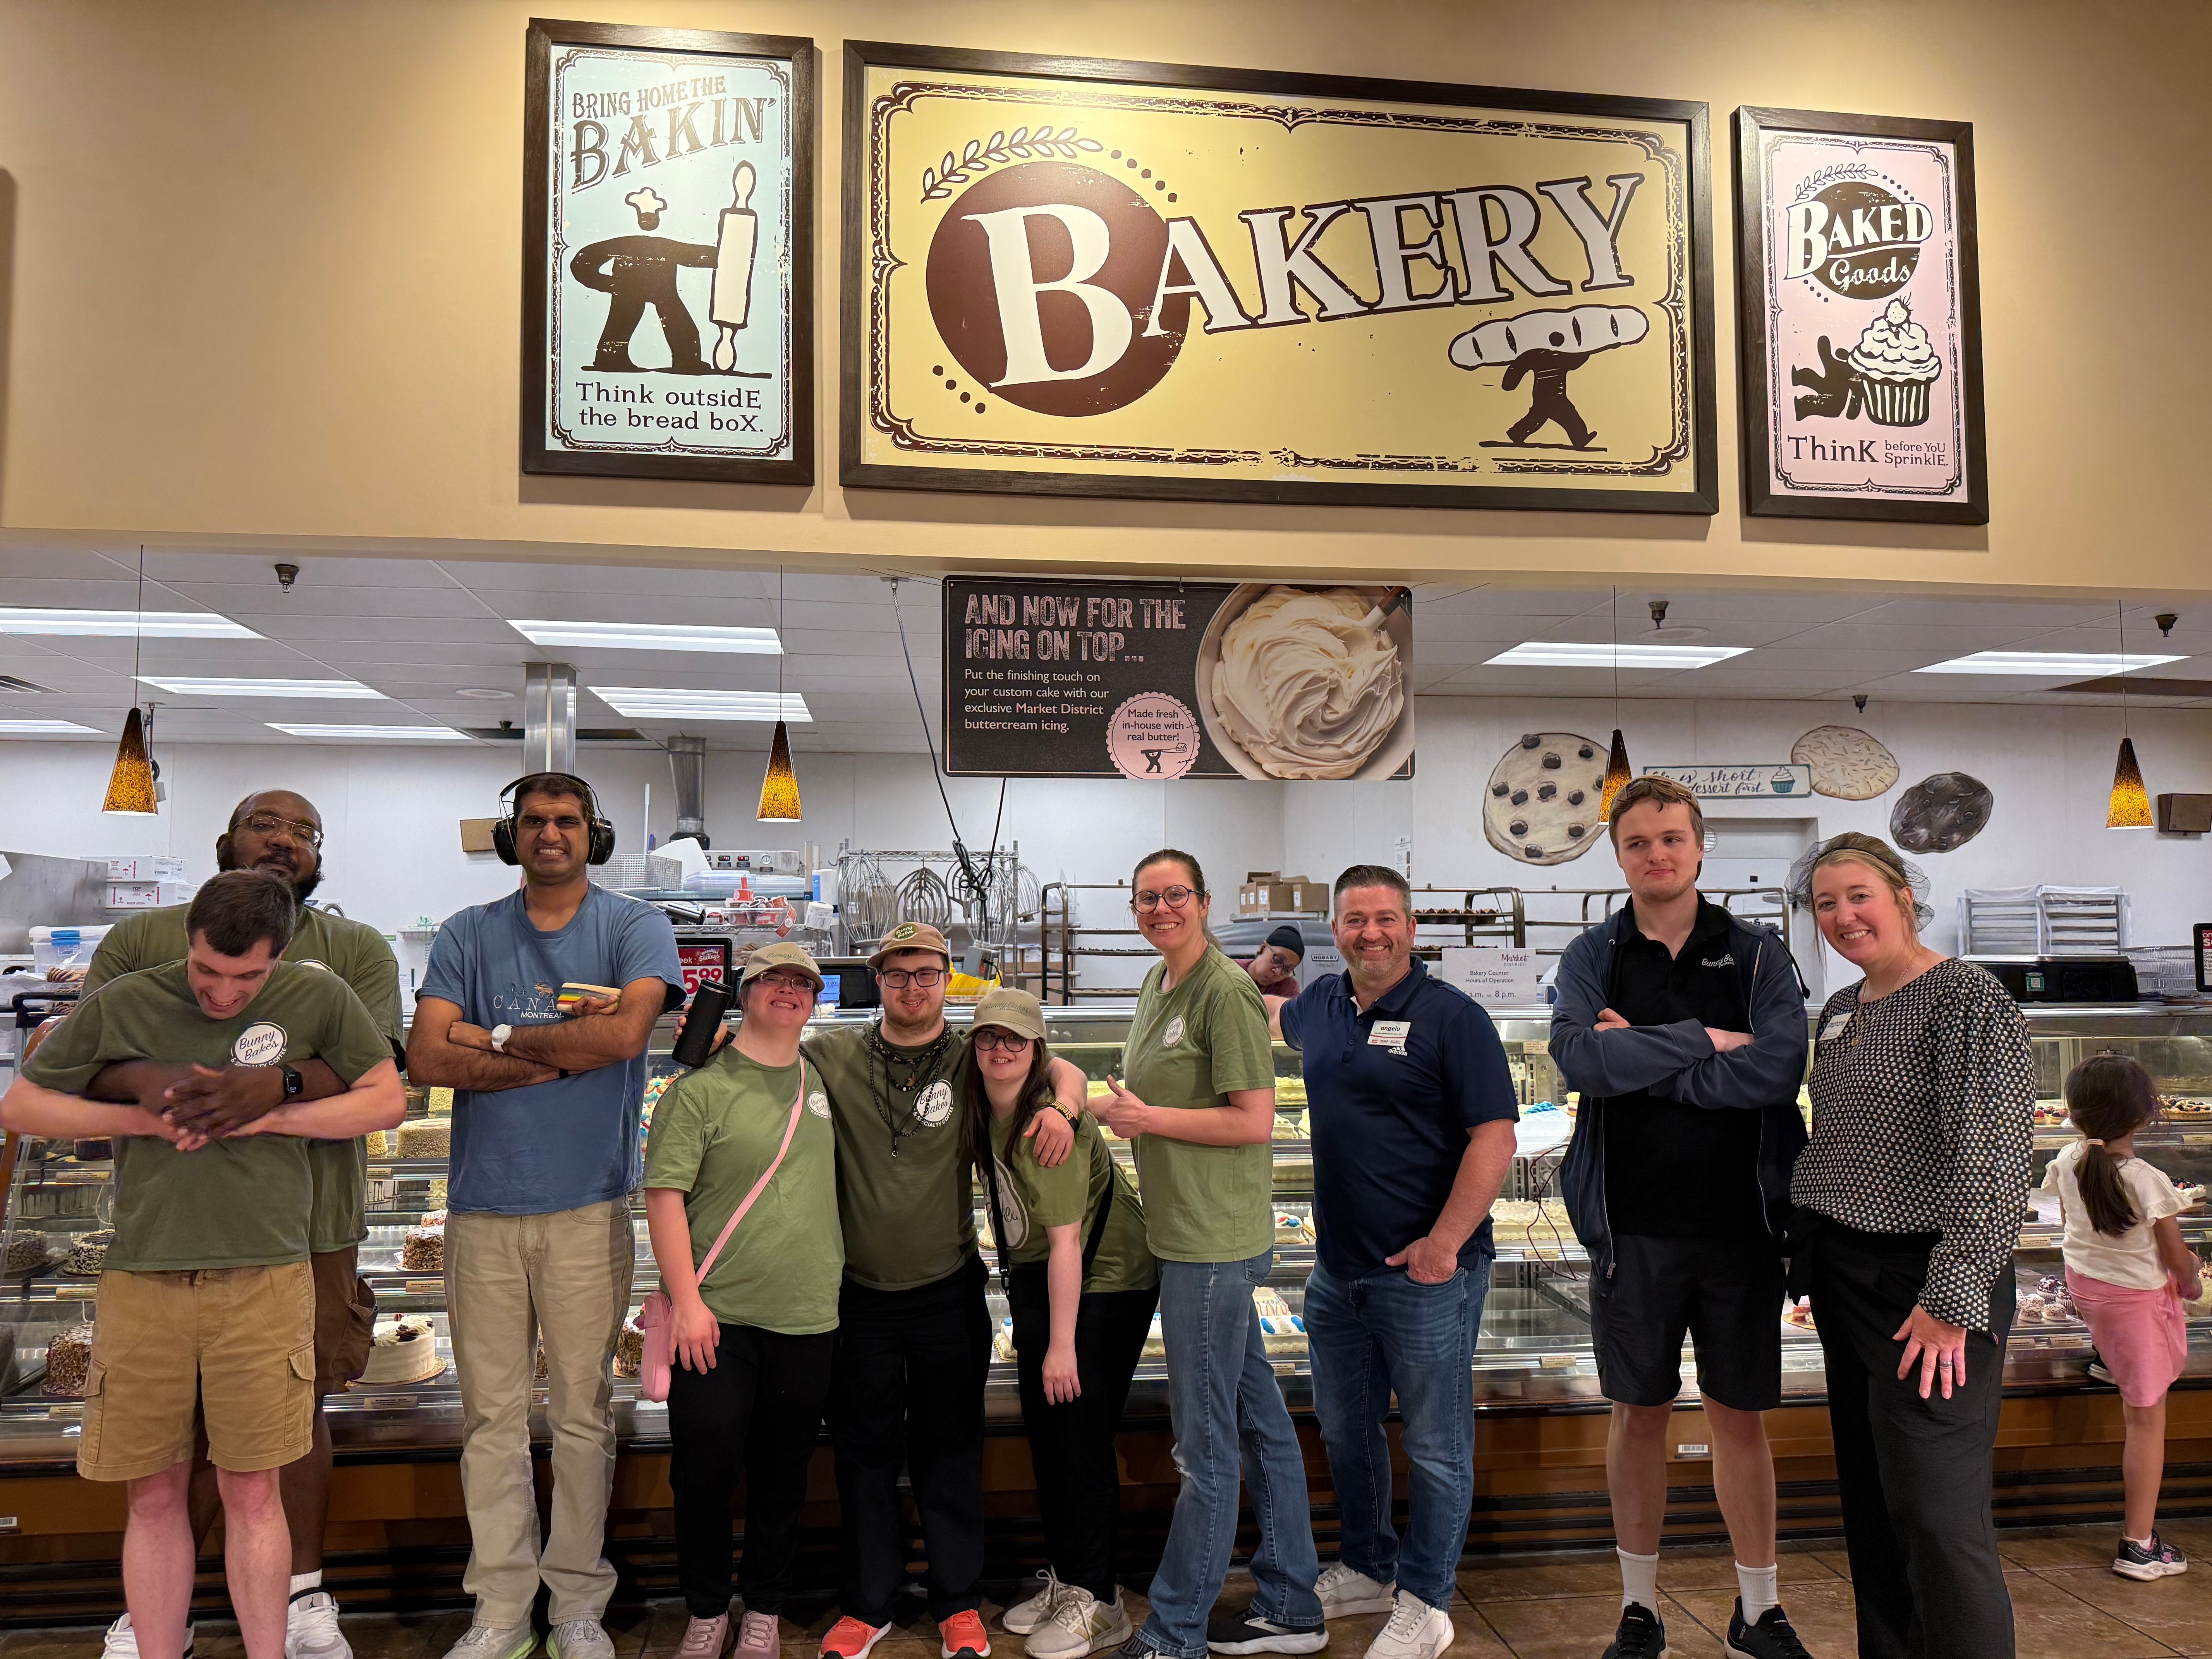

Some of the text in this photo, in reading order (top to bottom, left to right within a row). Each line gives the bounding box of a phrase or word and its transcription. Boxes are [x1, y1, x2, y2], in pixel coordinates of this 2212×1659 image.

[572, 76, 726, 119] BRING HOME THE
[571, 98, 776, 194] BAKIN'
[1783, 201, 1933, 280] BAKED
[961, 173, 1644, 388] BAKERY
[1829, 256, 1910, 292] Goods
[576, 382, 761, 409] Think outsidE
[579, 407, 764, 432] the bread boX.
[1788, 435, 1879, 462] ThinK
[1885, 440, 1946, 453] before YoU
[1884, 453, 1949, 468] SprinklE.
[965, 594, 1186, 629] AND NOW FOR THE
[965, 629, 1144, 662] ICING ON TOP...
[965, 669, 1100, 684] Put the finishing touch on
[965, 688, 1109, 699] your custom cake with our
[965, 703, 1104, 714] exclusive Market District
[1128, 709, 1178, 718] Made fresh
[965, 719, 1070, 733] buttercream icing.
[1122, 721, 1161, 729] in-house
[1127, 732, 1179, 741] real butter!
[1680, 770, 1697, 783] is
[1703, 768, 1756, 783] short
[1689, 781, 1765, 795] dessert first
[699, 953, 720, 961] Savings
[1501, 954, 1528, 962] Market
[1702, 958, 1723, 968] Bunny
[493, 995, 556, 1011] CANA
[239, 1030, 276, 1049] Bunny
[245, 1040, 279, 1061] Bakes
[268, 1047, 287, 1066] COFFEE
[1388, 1047, 1408, 1056] adidas
[942, 1106, 954, 1124] COFFEE
[1051, 1101, 1073, 1120] Steeler
